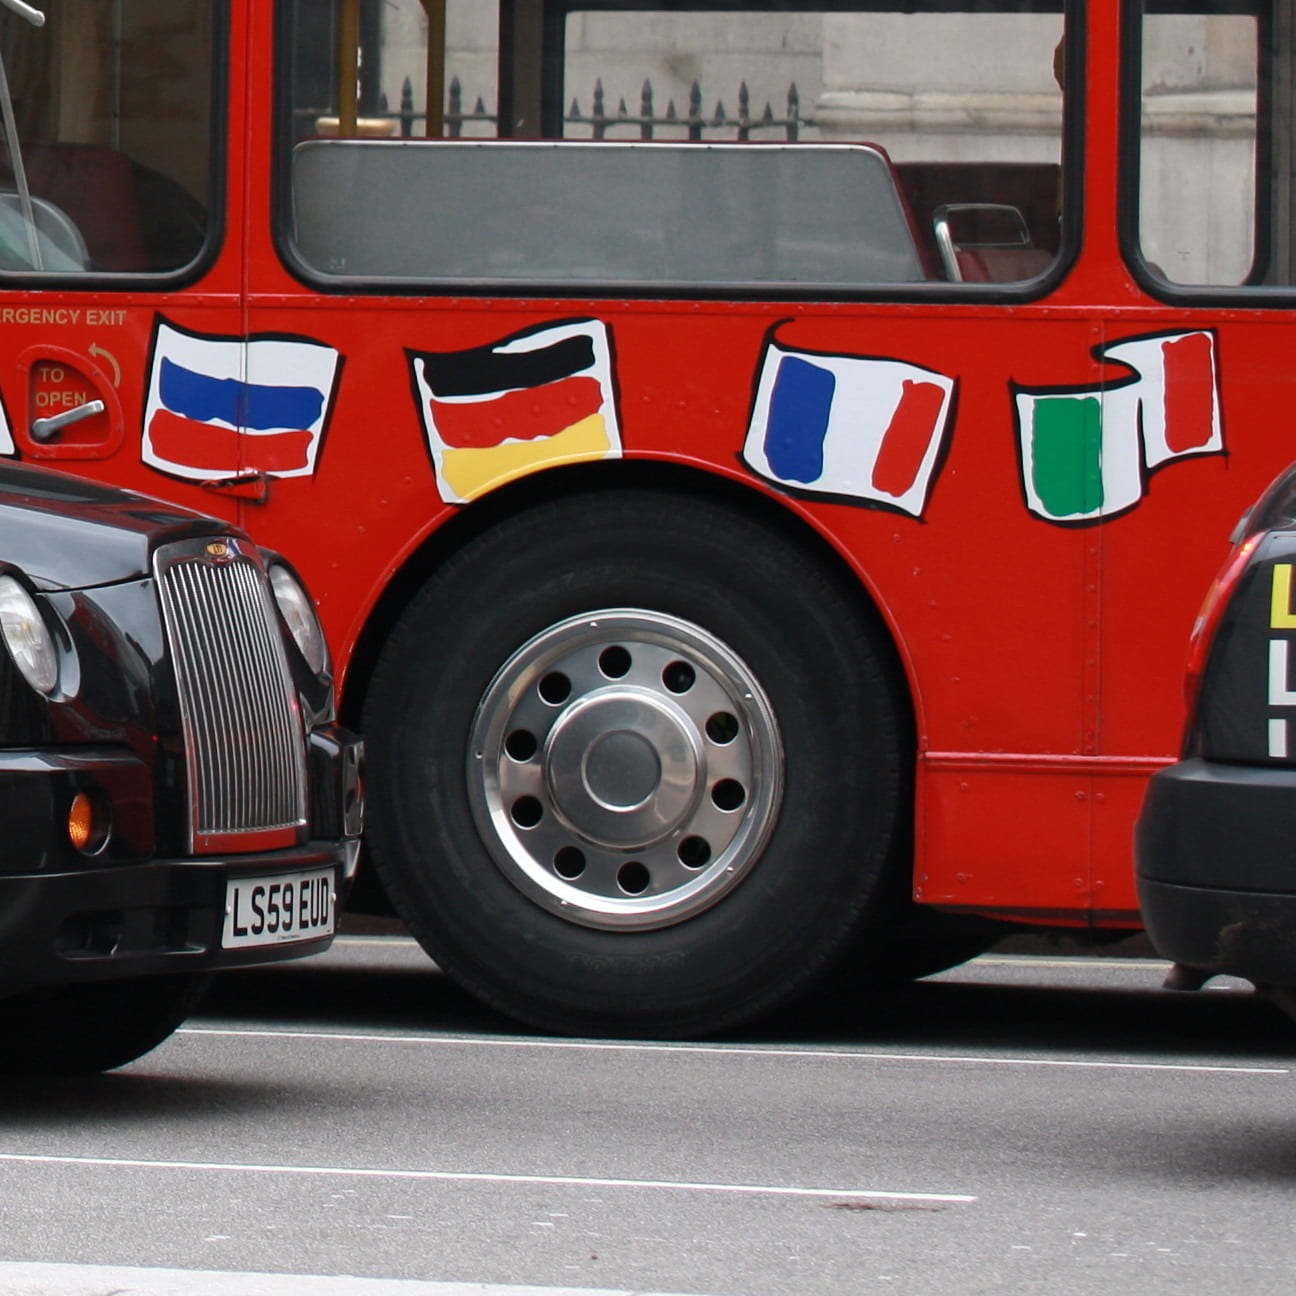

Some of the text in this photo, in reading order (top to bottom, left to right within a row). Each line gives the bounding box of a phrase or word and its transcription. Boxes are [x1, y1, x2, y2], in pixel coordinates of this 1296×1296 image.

[86, 309, 127, 326] EXIT
[40, 367, 64, 384] TO
[35, 390, 88, 407] OPEN
[233, 876, 329, 937] LS59 EUD
